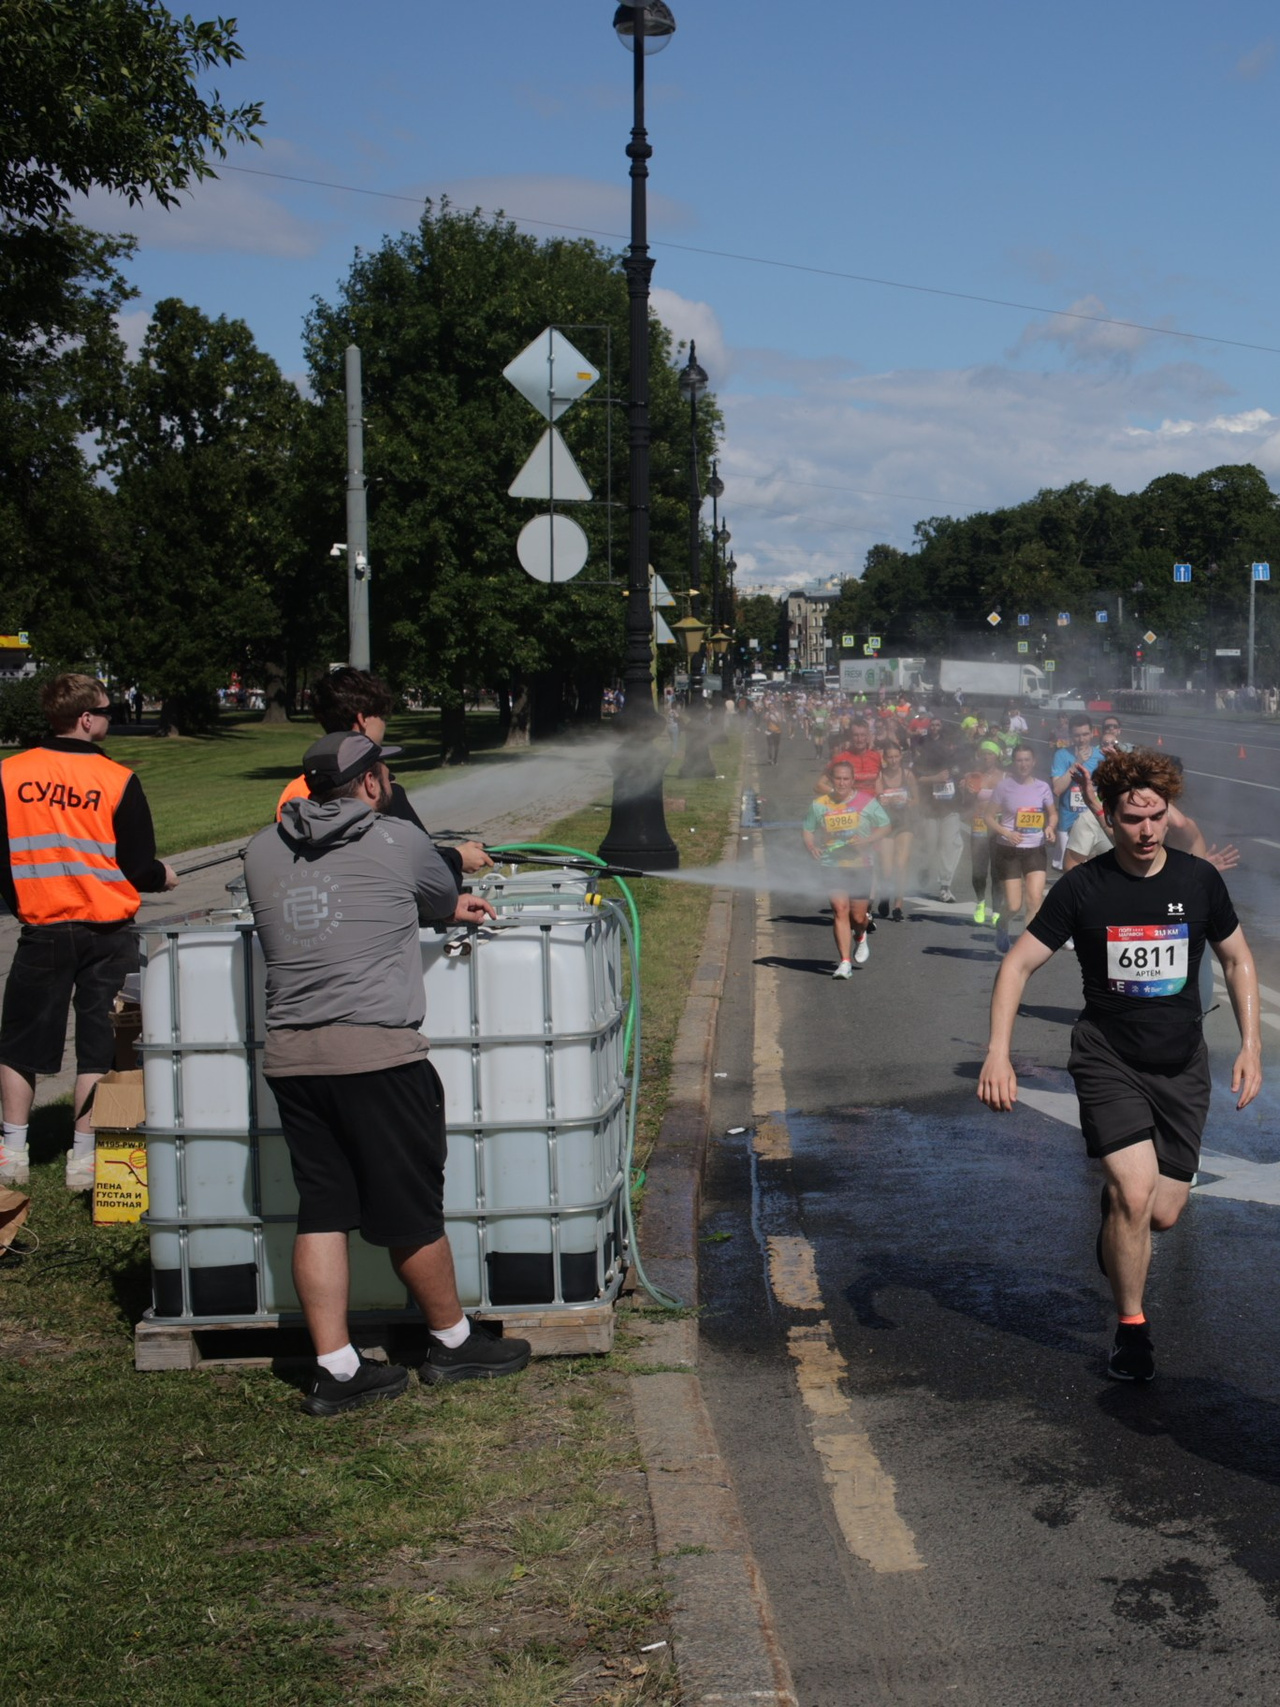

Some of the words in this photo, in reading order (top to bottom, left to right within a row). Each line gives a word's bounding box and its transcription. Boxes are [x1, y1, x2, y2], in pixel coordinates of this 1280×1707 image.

[18, 781, 101, 812] СУДЬЯ
[829, 815, 854, 828] 3986
[1020, 814, 1042, 824] 2317
[1119, 945, 1175, 969] 6811
[96, 1182, 122, 1190] ПЕНА
[96, 1191, 132, 1200] ГУСТАЯ
[96, 1200, 142, 1208] ПЛОТНАЯ
